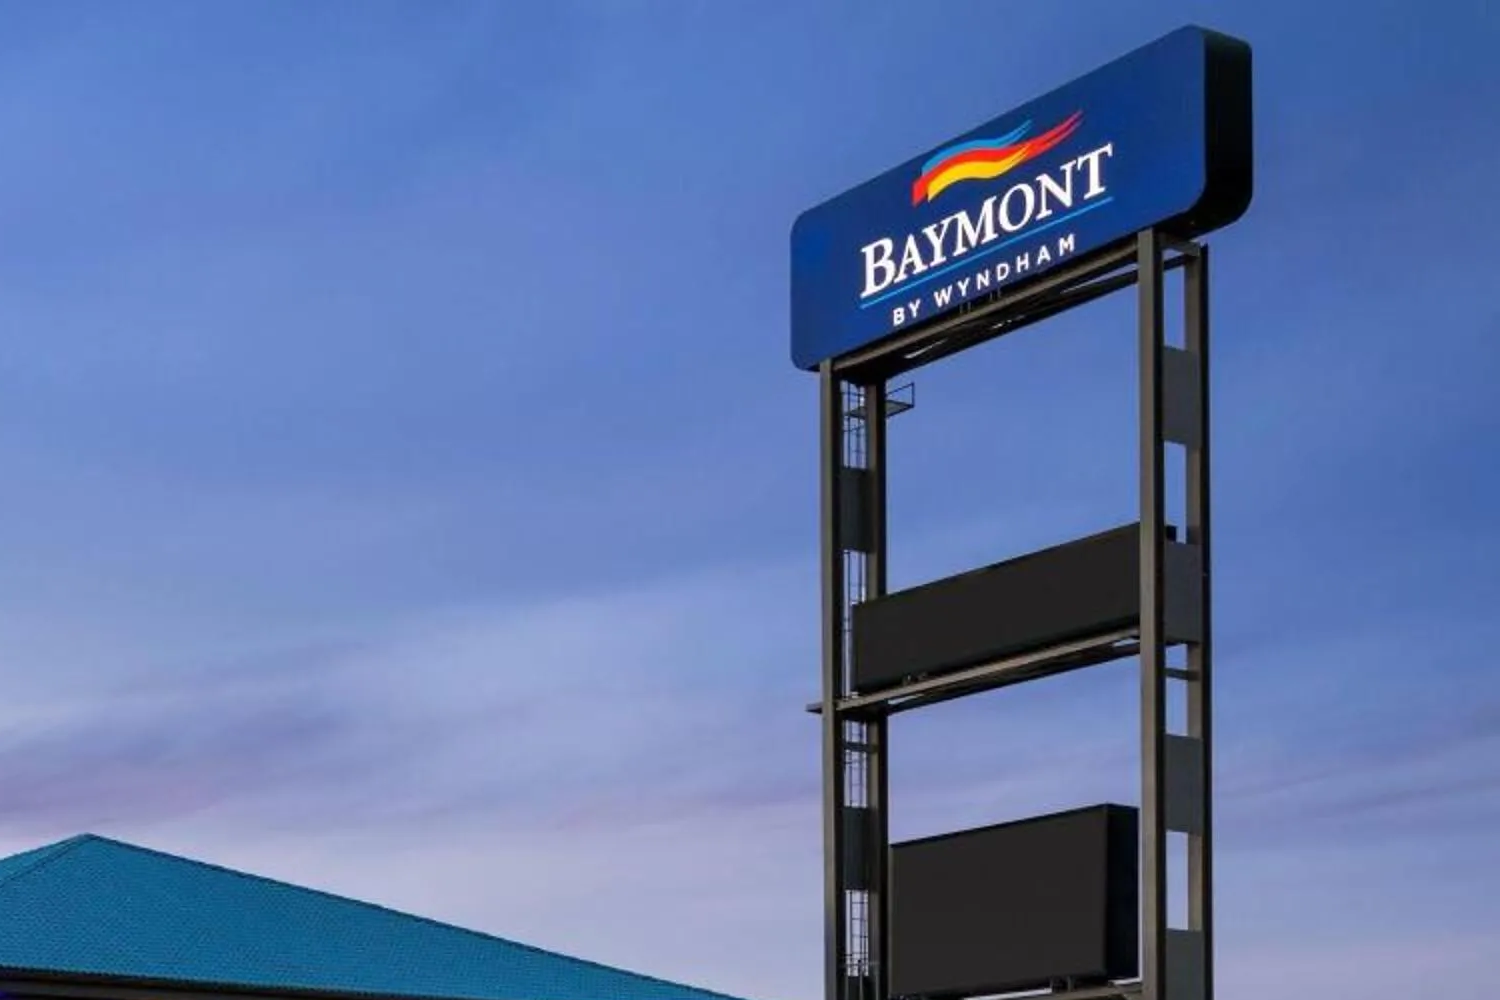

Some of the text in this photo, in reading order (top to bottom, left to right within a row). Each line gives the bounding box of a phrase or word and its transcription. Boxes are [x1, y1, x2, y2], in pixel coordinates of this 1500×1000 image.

[860, 143, 1114, 298] BAYMONT
[892, 233, 1076, 327] BY WYNDHAM
